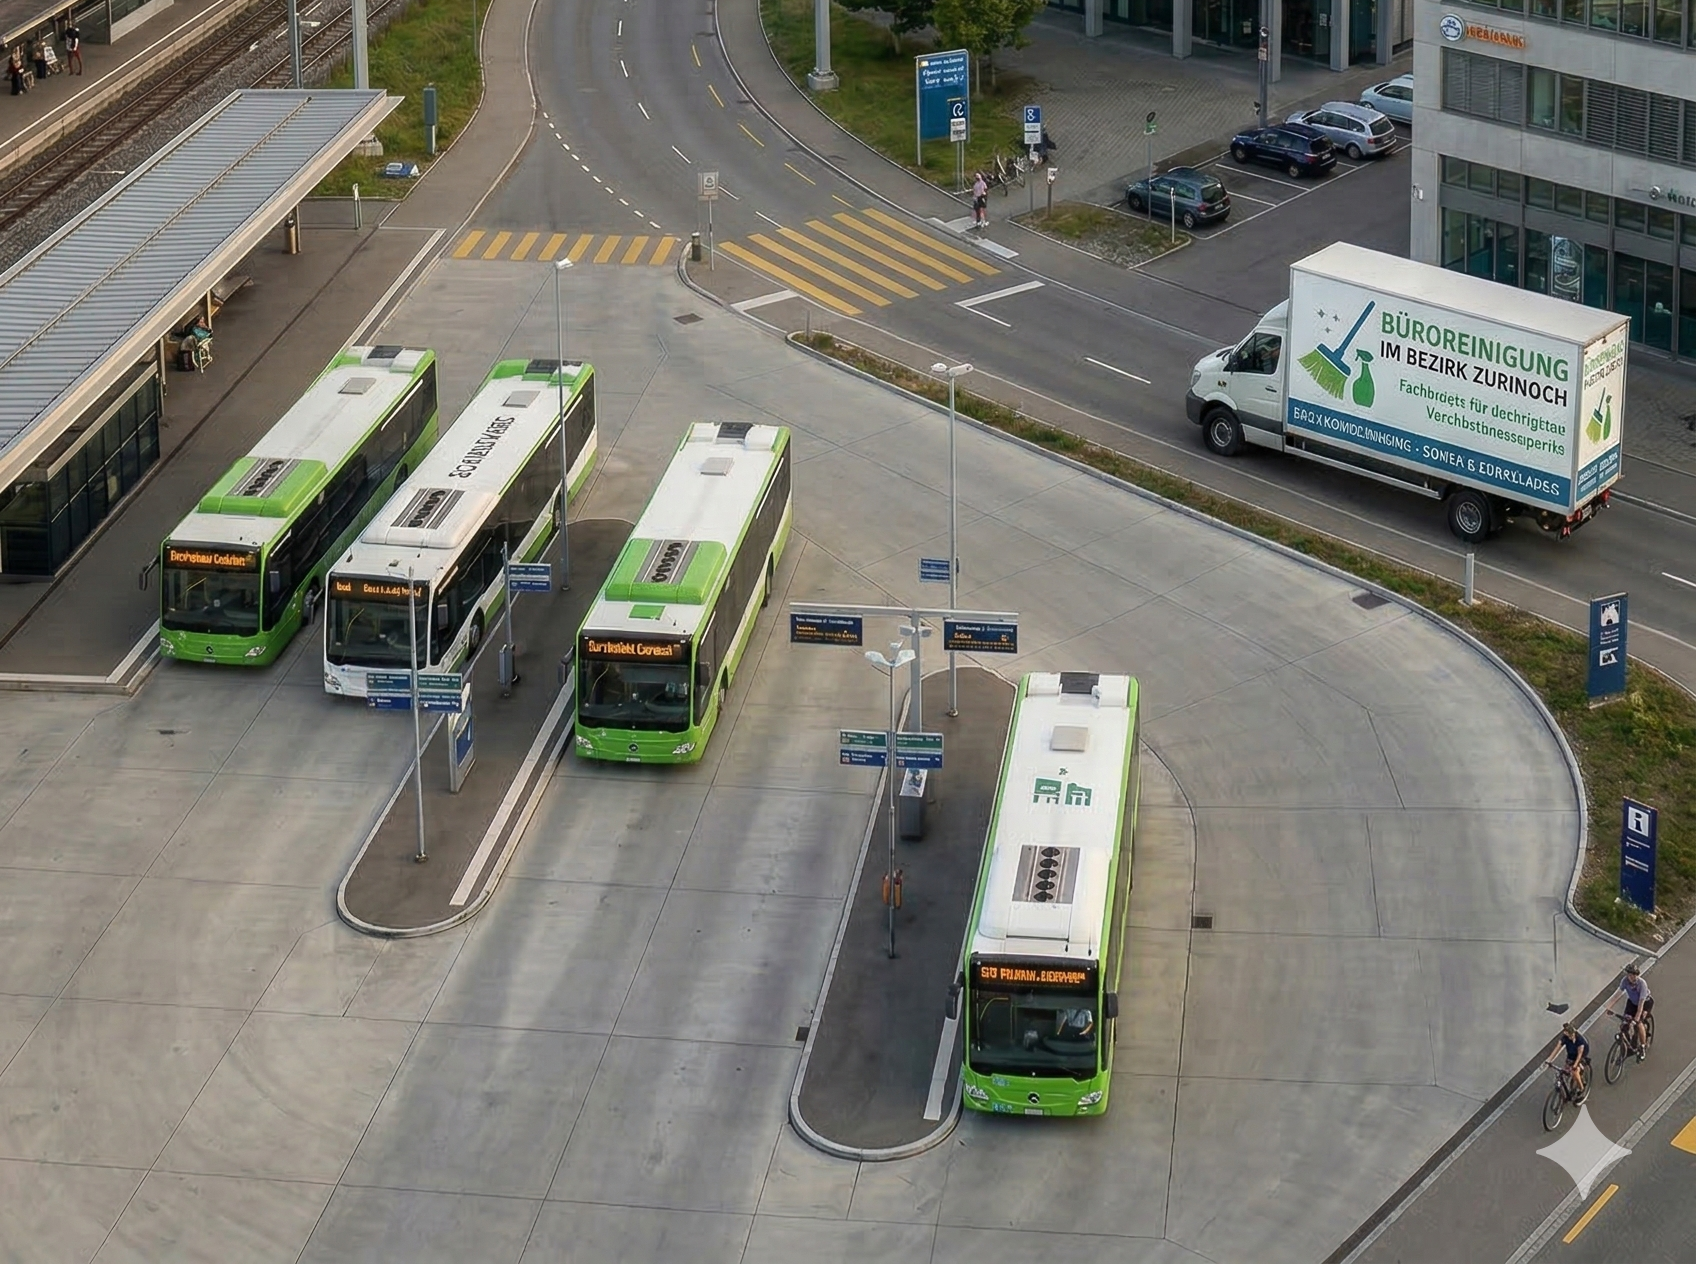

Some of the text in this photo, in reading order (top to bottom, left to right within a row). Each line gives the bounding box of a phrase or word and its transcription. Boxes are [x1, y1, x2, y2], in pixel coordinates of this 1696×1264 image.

[1380, 340, 1401, 362] IM
[1406, 347, 1468, 381] BEZIRK
[1472, 365, 1568, 407] ZURINOCH
[1381, 311, 1569, 382] BÜROREINIGUNG
[1469, 396, 1489, 415] für
